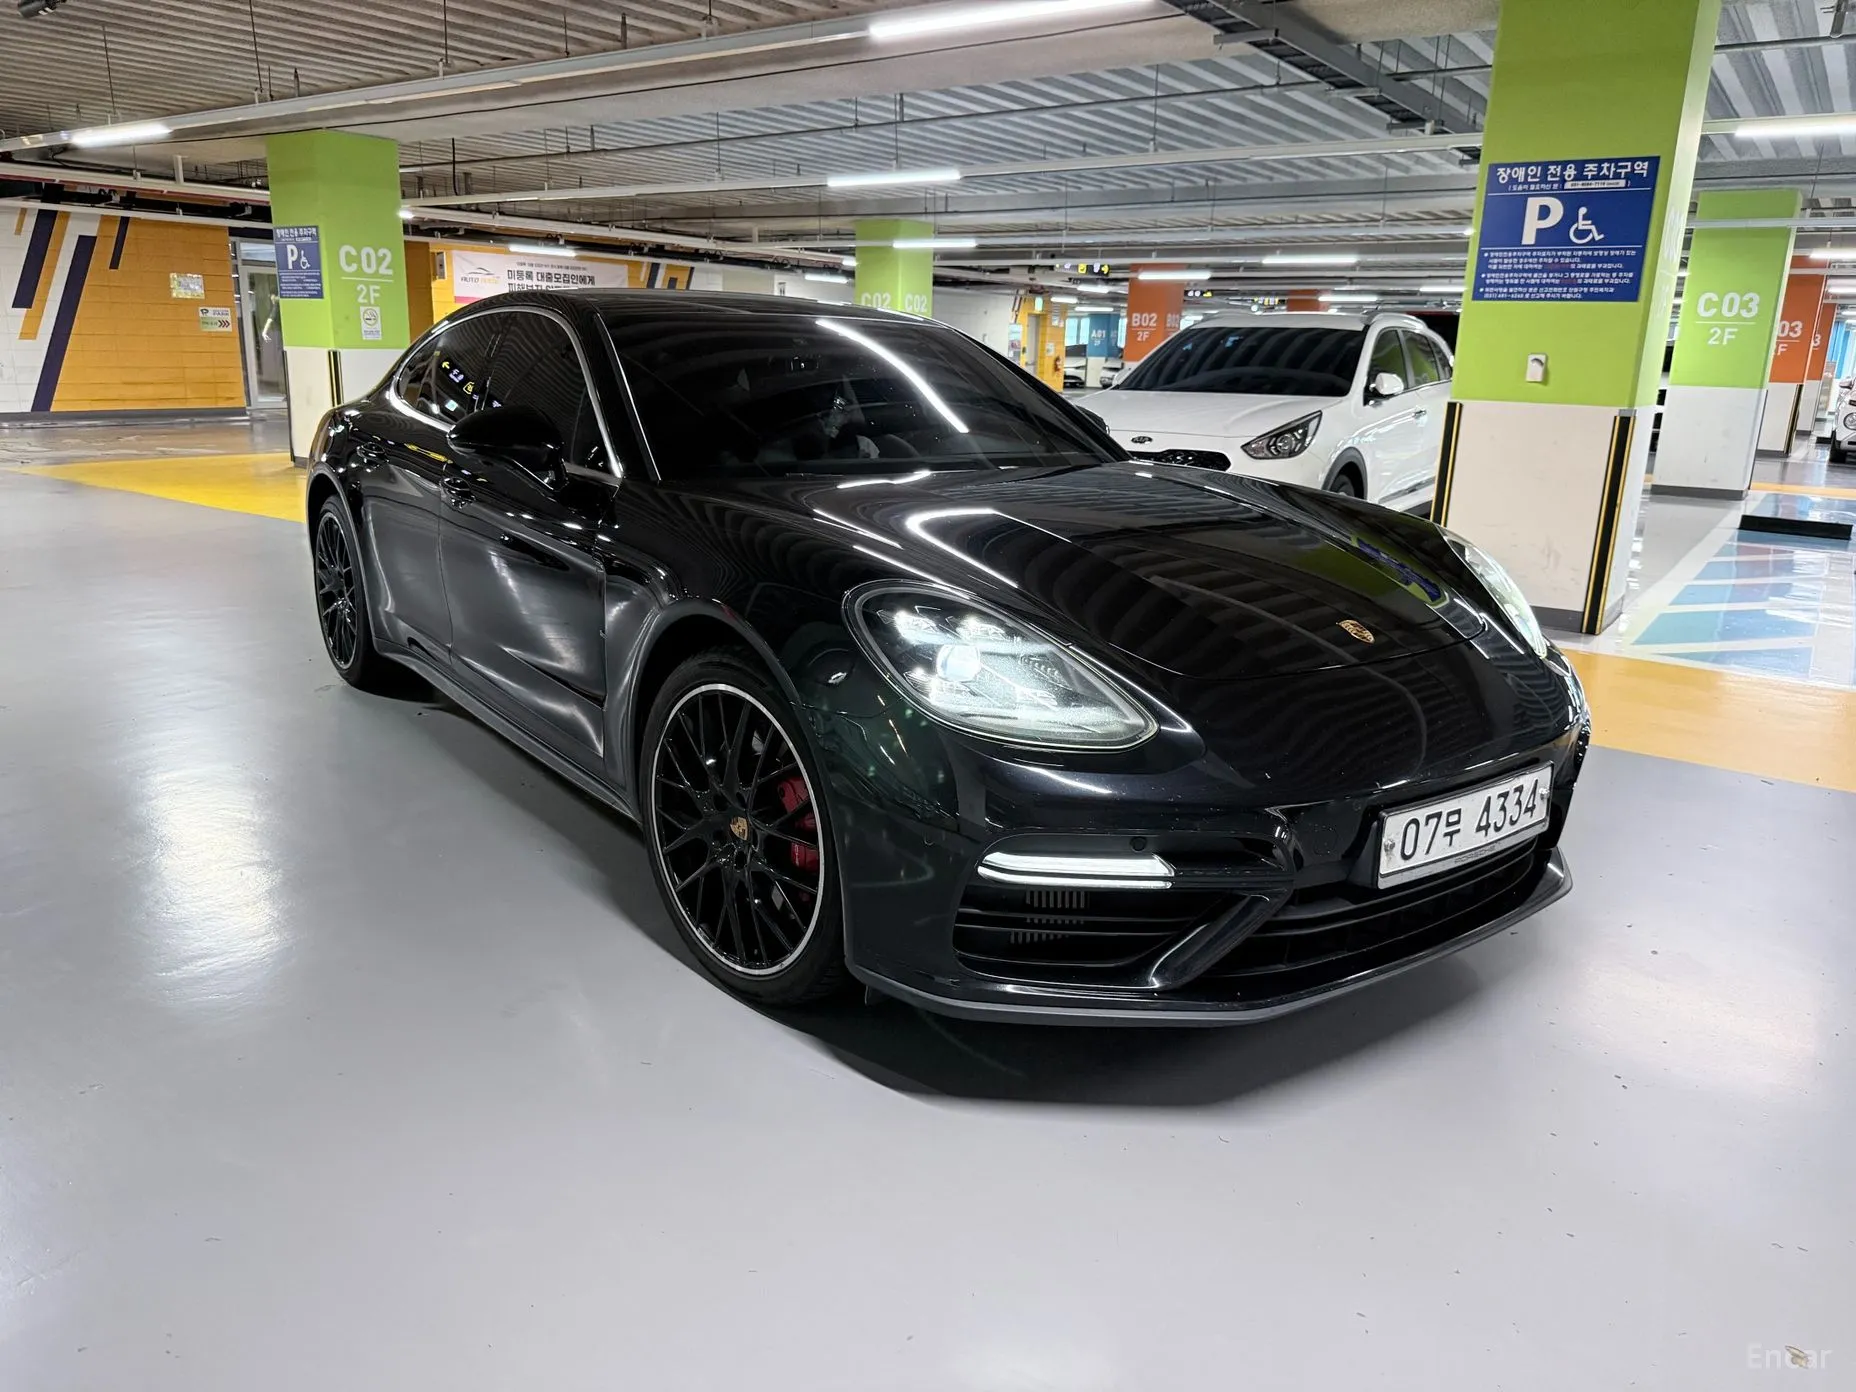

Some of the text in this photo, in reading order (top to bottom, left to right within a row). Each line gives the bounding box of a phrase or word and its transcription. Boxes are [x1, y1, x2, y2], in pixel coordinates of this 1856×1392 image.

[1496, 161, 1649, 183] 장애인 전용 주차구역
[1521, 197, 1564, 245] P
[286, 244, 299, 270] P
[339, 244, 394, 276] C02
[507, 269, 533, 281] 미등록
[536, 271, 596, 286] 대출모집인에게
[356, 284, 381, 305] 2F
[860, 293, 891, 309] C02
[905, 293, 928, 313] C02
[1696, 292, 1760, 318] C03
[1131, 313, 1157, 327] B02
[1777, 320, 1803, 338] 03
[1091, 330, 1106, 338] A01
[1137, 332, 1150, 342] 2F
[1707, 326, 1738, 346] 2F
[1400, 778, 1539, 861] 07무 4334
